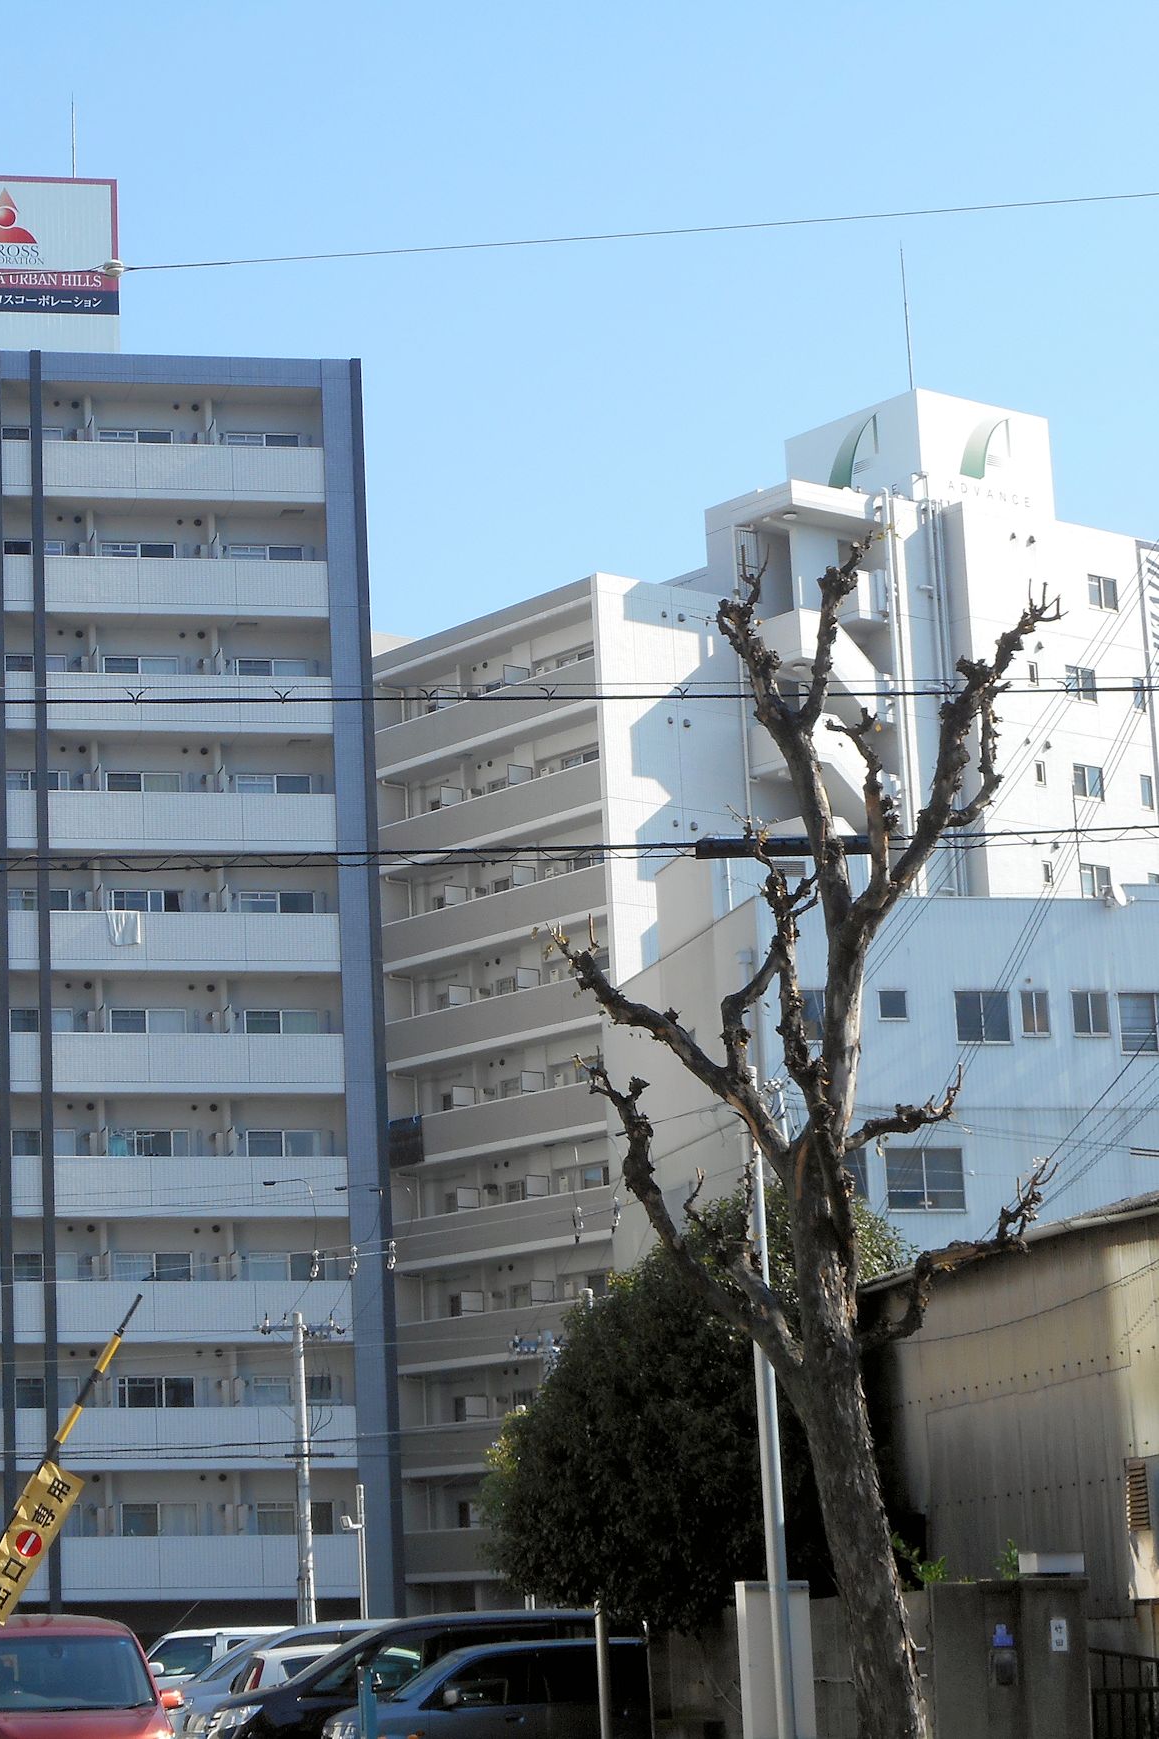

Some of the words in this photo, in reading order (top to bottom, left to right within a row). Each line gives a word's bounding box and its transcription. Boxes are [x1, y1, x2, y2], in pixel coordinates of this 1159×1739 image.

[9, 273, 58, 286] URBAN
[61, 274, 102, 288] HILLS
[948, 480, 1032, 508] ADVANCE
[31, 1477, 71, 1529] 専用
